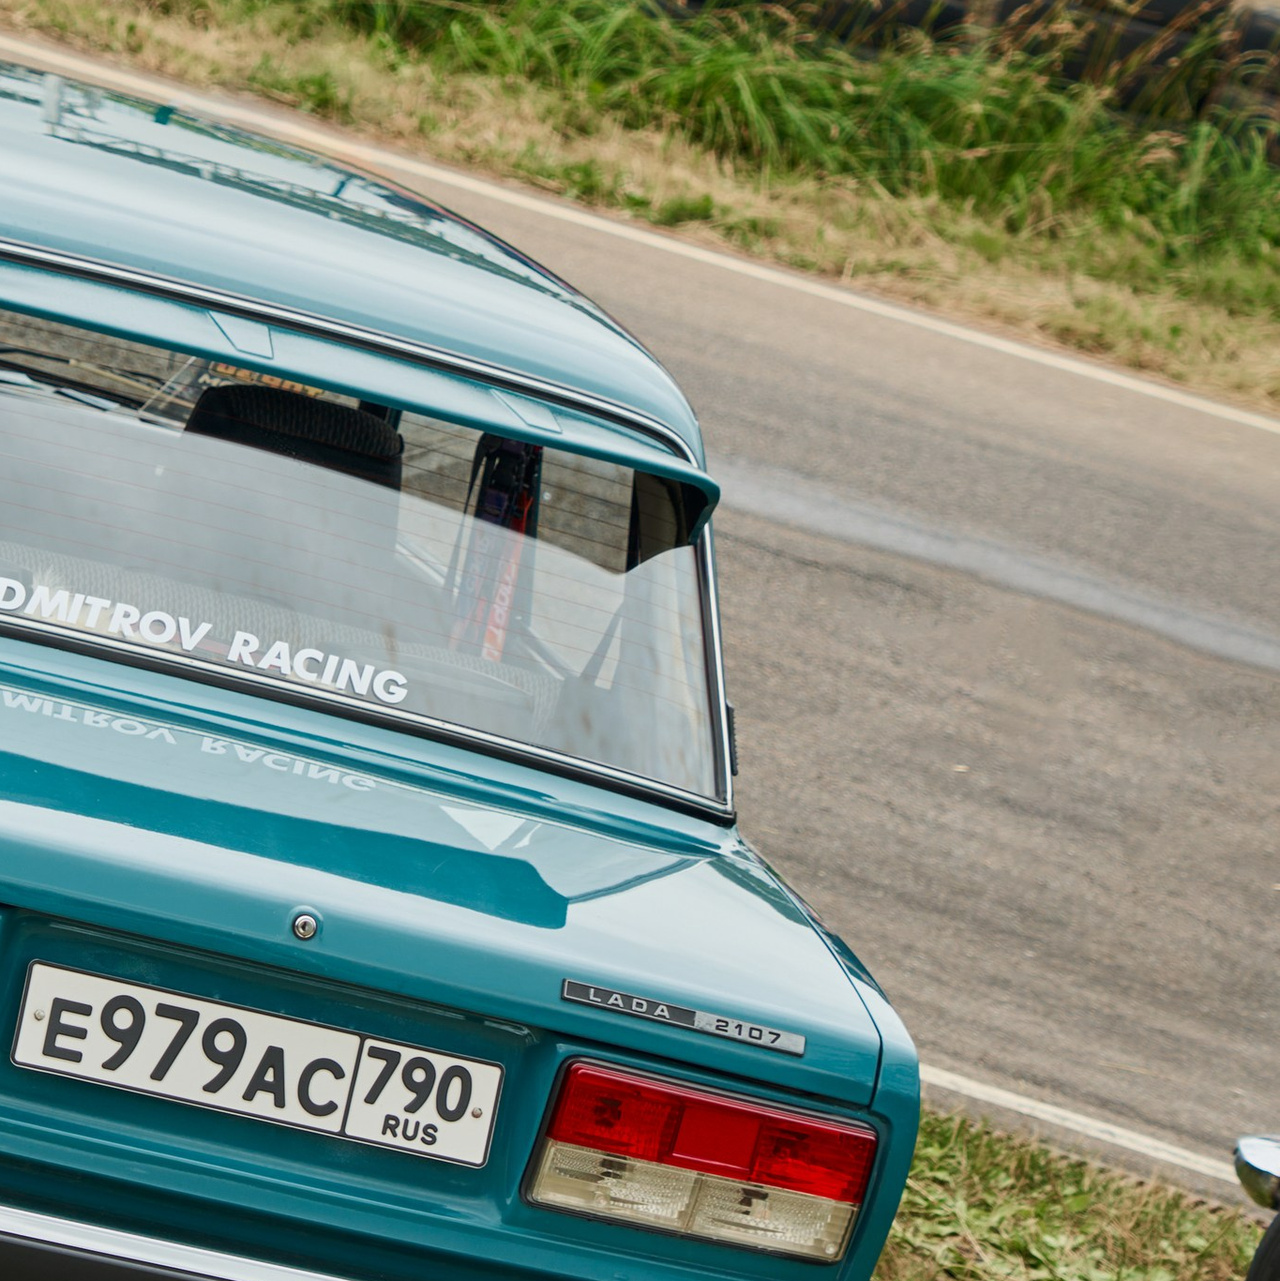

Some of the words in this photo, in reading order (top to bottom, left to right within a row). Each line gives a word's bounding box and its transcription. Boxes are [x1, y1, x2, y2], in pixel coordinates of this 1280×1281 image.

[226, 630, 409, 704] RACING
[588, 987, 670, 1019] LADA
[714, 1018, 782, 1045] 2107
[42, 995, 346, 1117] E979AC
[363, 1046, 472, 1122] 790
[381, 1114, 438, 1145] RUS
